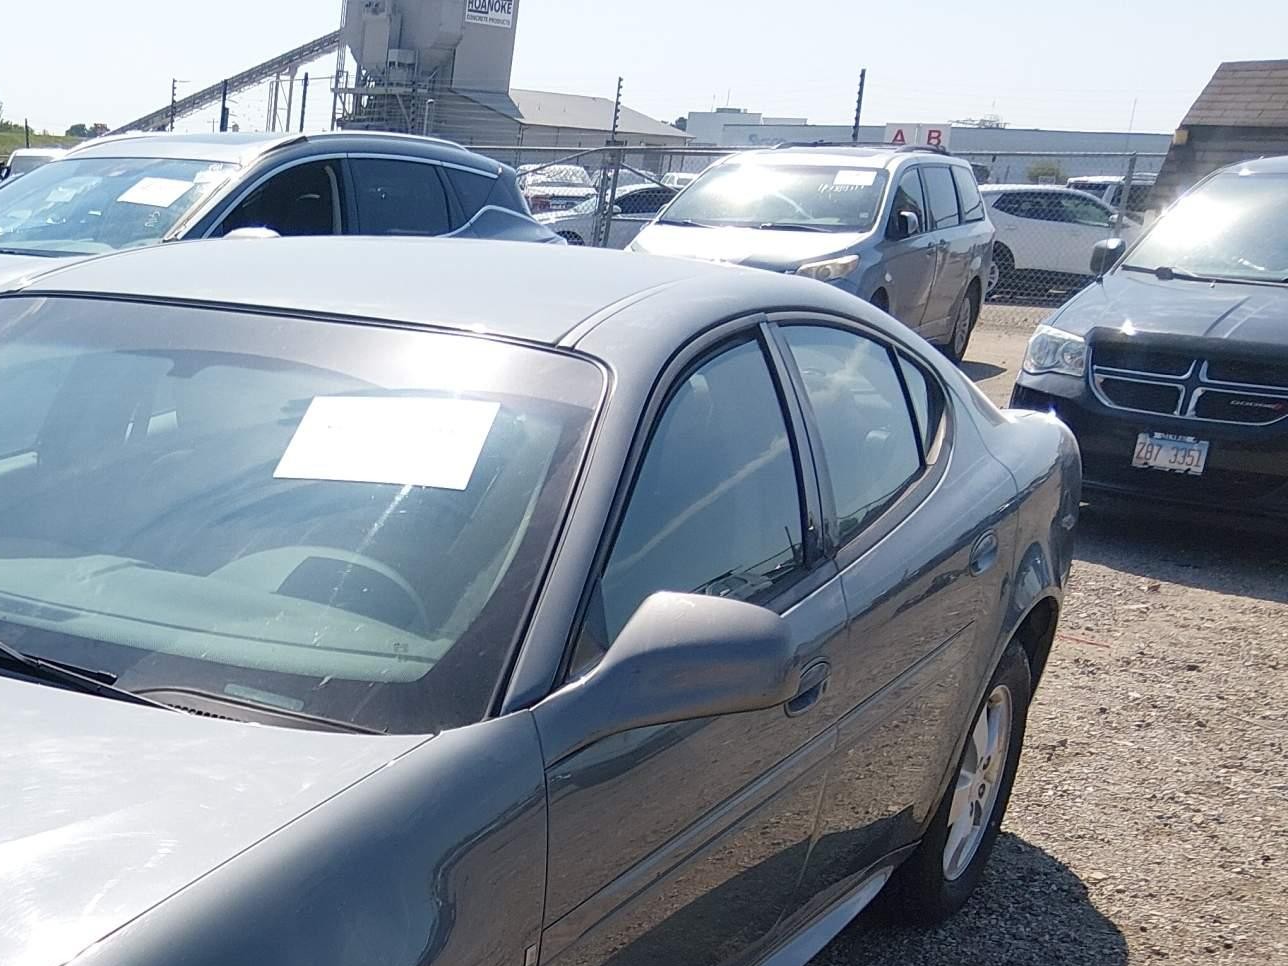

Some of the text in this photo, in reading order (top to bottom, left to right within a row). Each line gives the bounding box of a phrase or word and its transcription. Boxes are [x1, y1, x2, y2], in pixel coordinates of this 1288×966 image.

[467, 0, 512, 14] ROANOKE
[467, 14, 511, 26] CONCRETE PRODUCTS
[892, 129, 942, 145] A B
[1168, 446, 1202, 468] 3351
